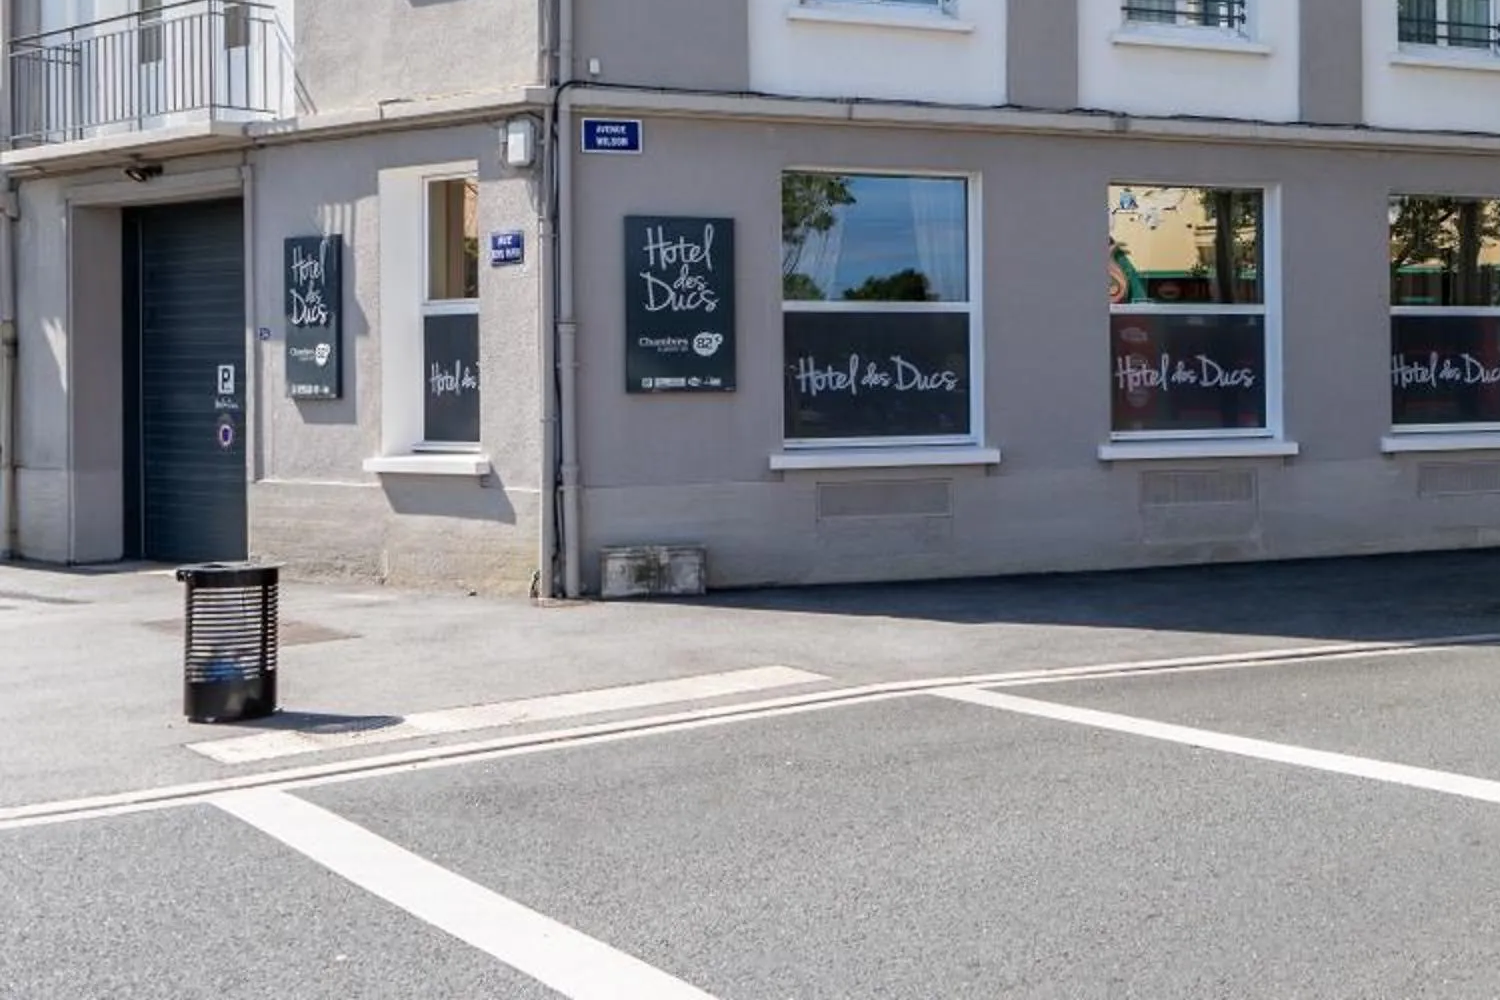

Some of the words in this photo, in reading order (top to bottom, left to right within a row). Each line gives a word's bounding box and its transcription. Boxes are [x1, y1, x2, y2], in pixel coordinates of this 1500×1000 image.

[595, 124, 627, 134] AVENUE
[595, 136, 629, 147] WILSON
[290, 239, 327, 287] Hotel
[642, 222, 715, 272] Hotel
[639, 270, 720, 313] Ducs
[673, 263, 708, 292] des
[289, 288, 328, 325] Ducs
[222, 368, 230, 390] P
[429, 359, 462, 397] Hotel
[796, 353, 859, 396] Hotel
[861, 362, 892, 388] des
[890, 354, 958, 392] Ducs
[1114, 353, 1170, 393] Hotel
[1171, 361, 1197, 385] des
[1195, 355, 1256, 388] Ducs
[1390, 351, 1438, 389] Hotel
[1439, 359, 1461, 381] des
